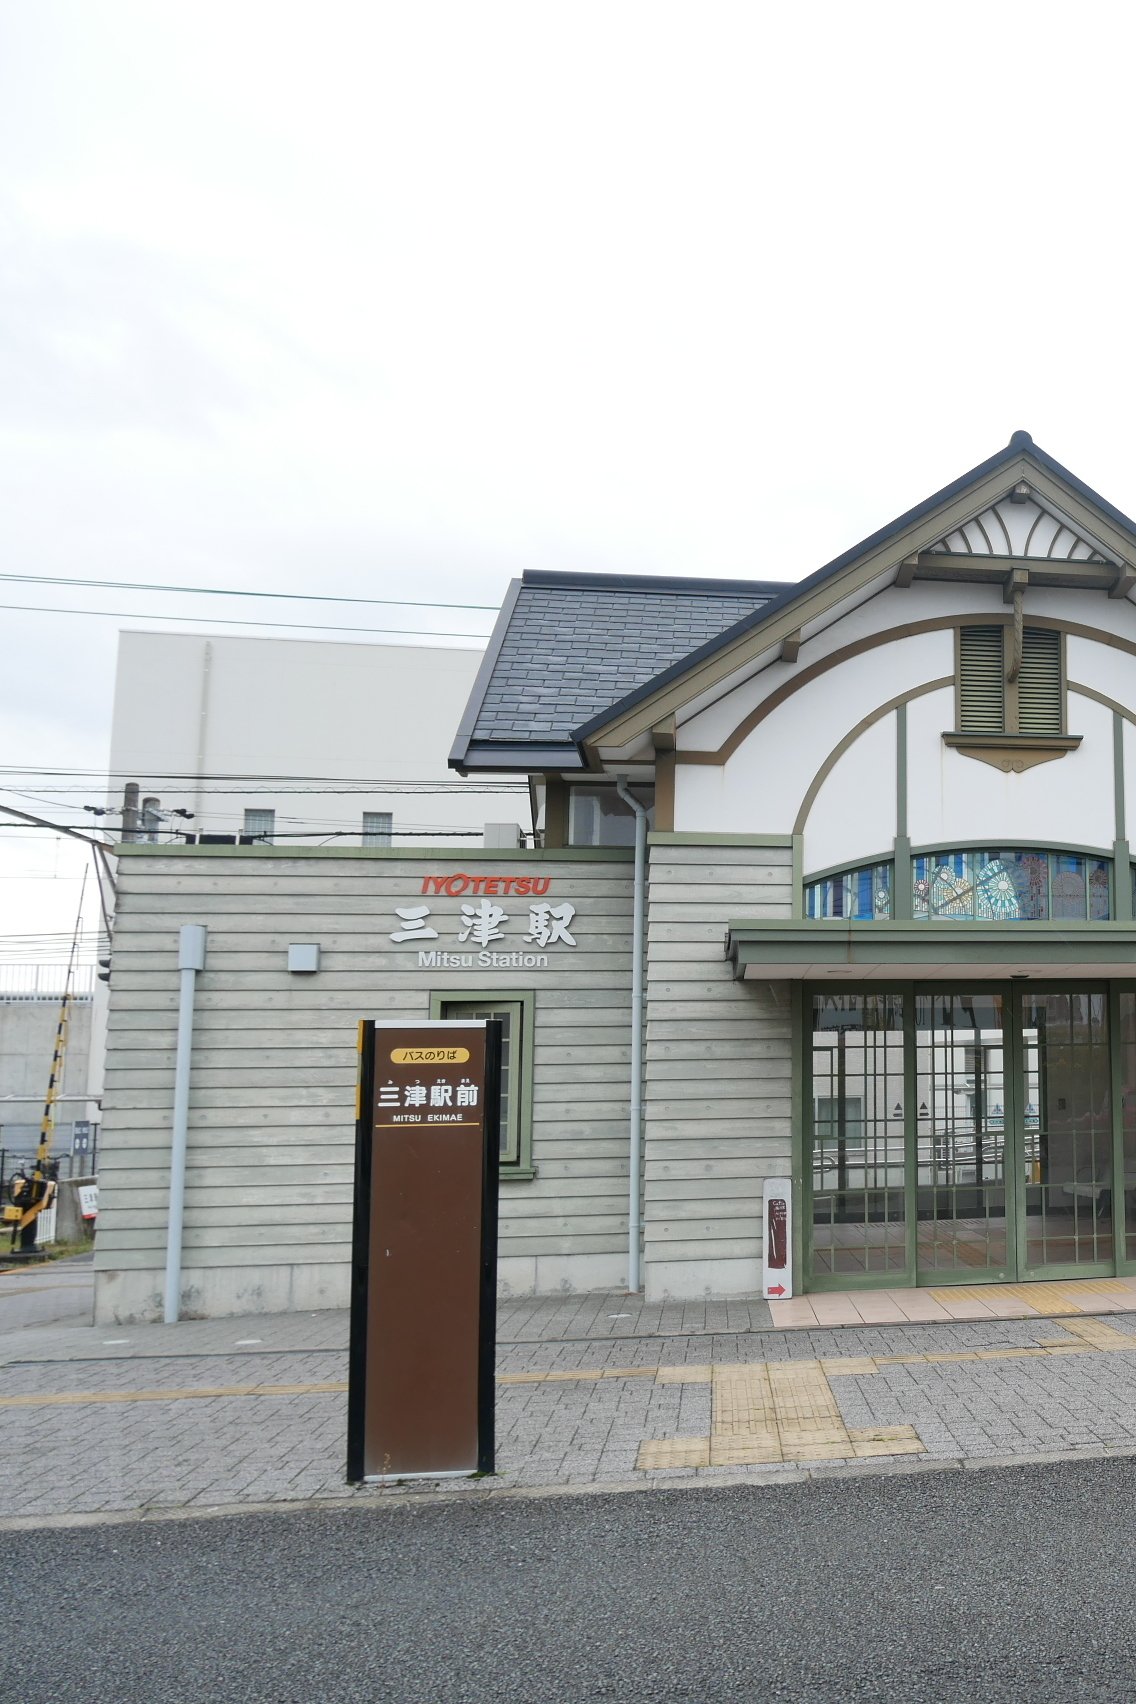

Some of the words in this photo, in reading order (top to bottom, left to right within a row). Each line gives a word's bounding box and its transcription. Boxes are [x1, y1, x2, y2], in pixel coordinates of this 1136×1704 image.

[421, 873, 551, 896] IYOTETSU
[388, 898, 577, 948] 三津駅
[417, 951, 473, 968] Mitsu
[477, 951, 548, 968] Station
[402, 1050, 457, 1061] バスのりば
[378, 1084, 479, 1107] 三津駅前
[393, 1114, 421, 1122] MITSU
[427, 1113, 463, 1121] EKIMAE
